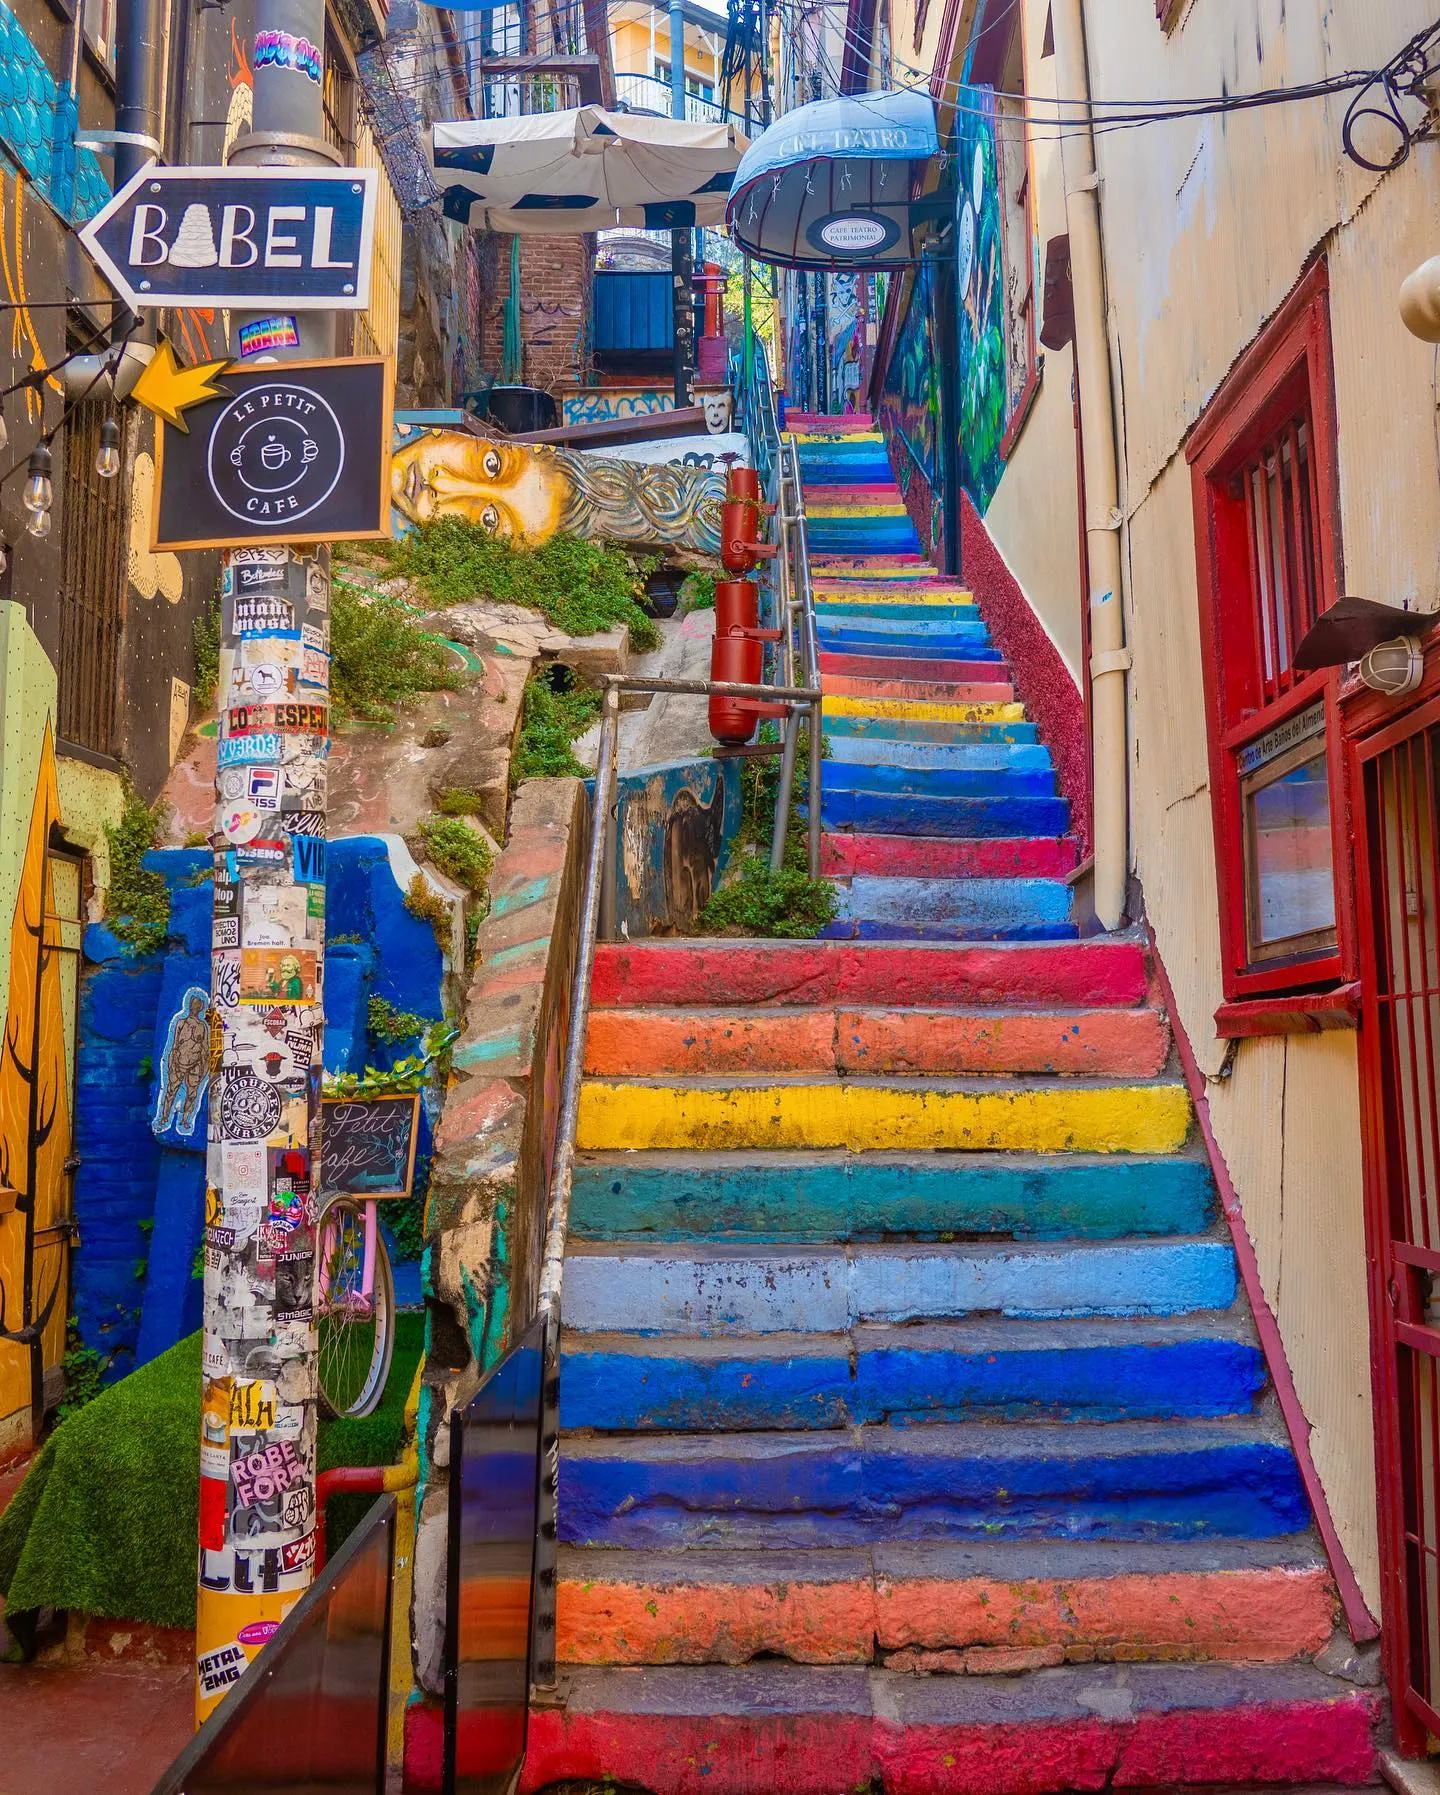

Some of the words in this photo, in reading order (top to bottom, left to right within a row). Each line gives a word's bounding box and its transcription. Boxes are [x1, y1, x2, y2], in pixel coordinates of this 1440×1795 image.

[129, 203, 353, 268] BABEL
[830, 234, 878, 242] PATRIMONIAL
[850, 226, 878, 234] TEATRO
[233, 402, 255, 422] LE
[260, 393, 316, 415] PETIT
[247, 495, 299, 514] CAFE
[231, 1079, 279, 1110] DOUBLE
[223, 1110, 271, 1138] BARREL
[329, 1103, 400, 1137] Petit
[231, 1441, 296, 1482] ROBE
[197, 1646, 245, 1676] METAL
